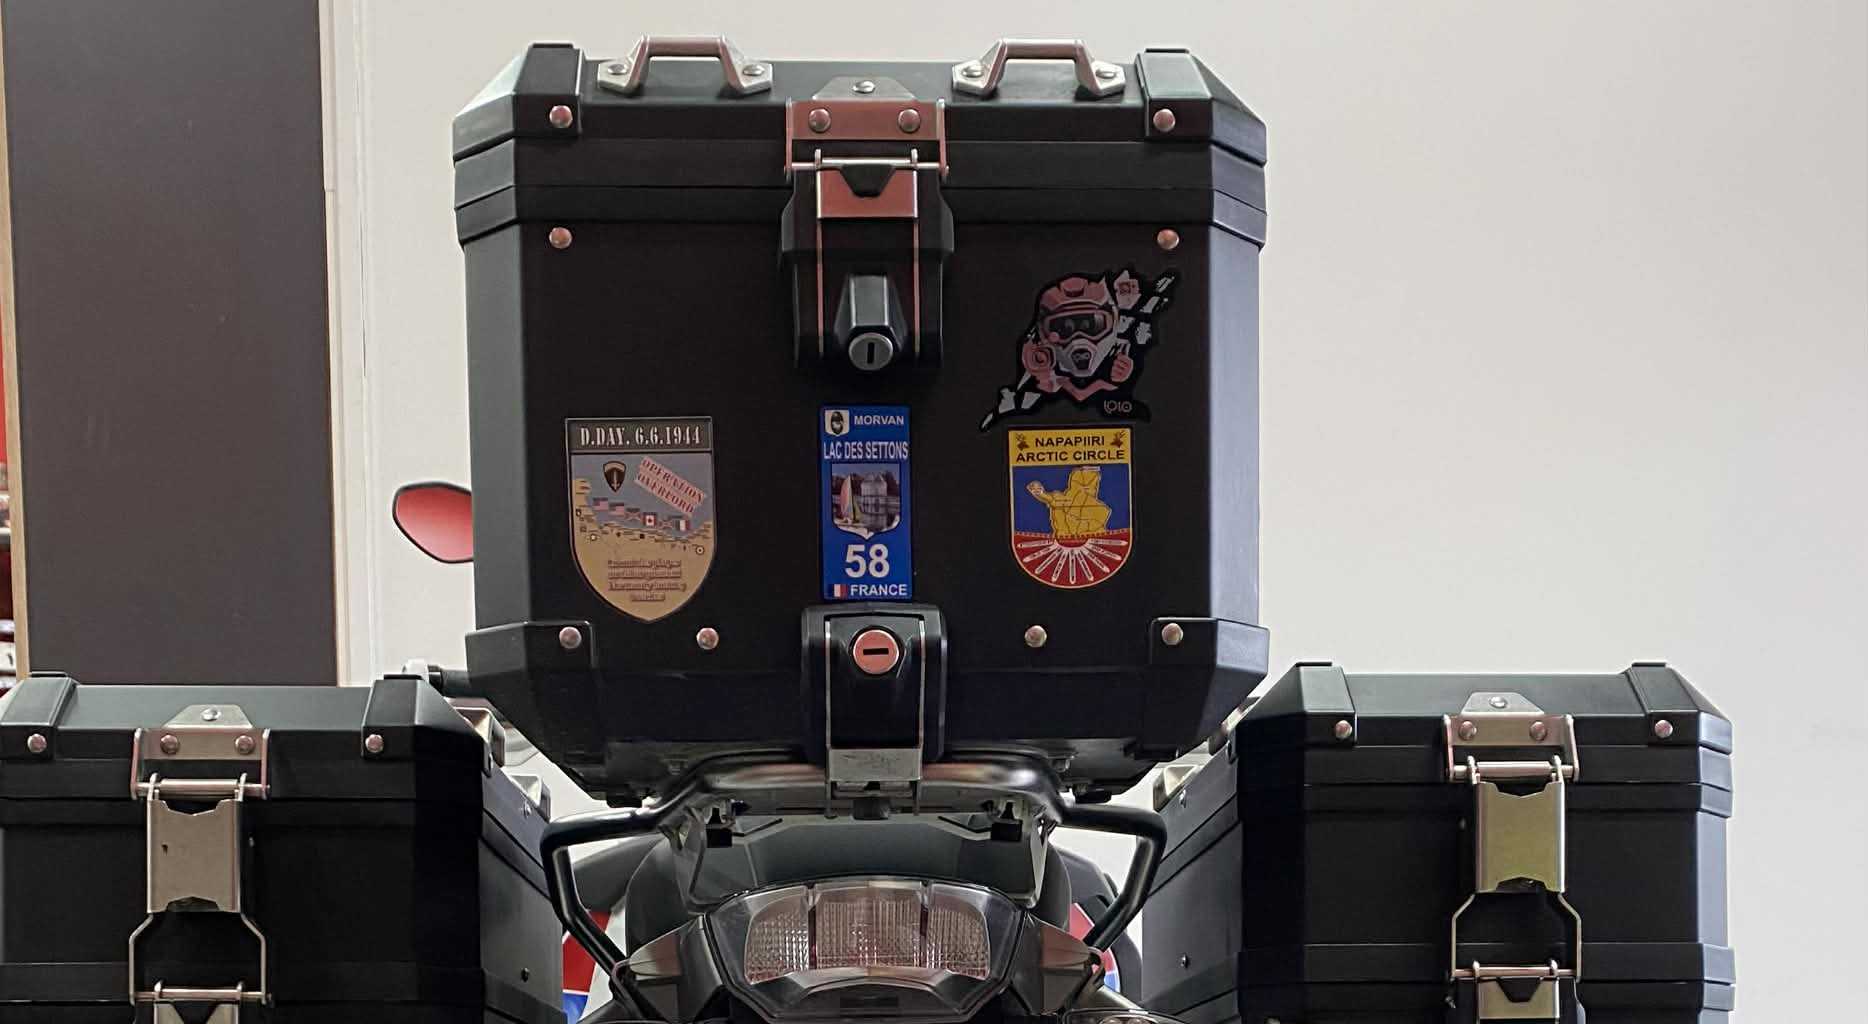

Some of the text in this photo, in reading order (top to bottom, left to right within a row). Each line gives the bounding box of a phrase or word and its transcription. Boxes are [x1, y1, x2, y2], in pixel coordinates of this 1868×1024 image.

[853, 415, 904, 426] MORVAN
[1035, 436, 1105, 447] NAPAPIIRI
[823, 441, 909, 460] LAC DES SETTONS
[1016, 449, 1125, 463] ARCTIC CIRCLE
[844, 543, 890, 579] 58
[850, 583, 908, 597] FRANCE
